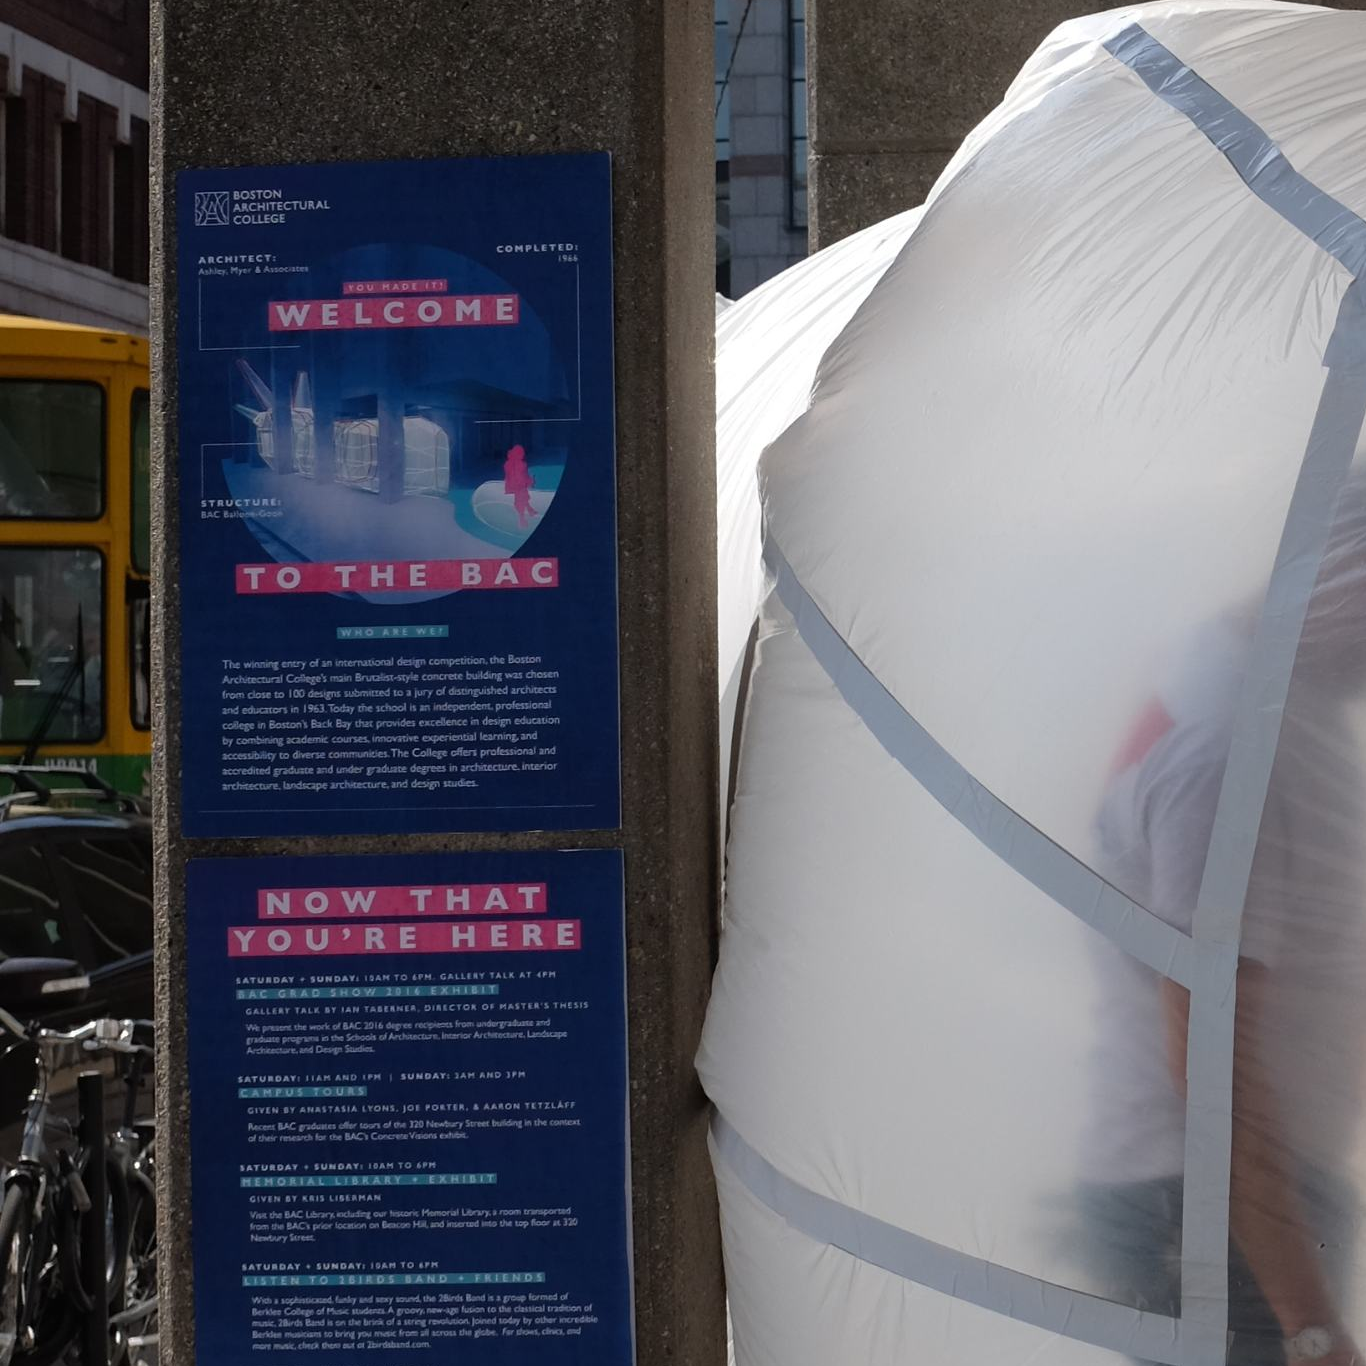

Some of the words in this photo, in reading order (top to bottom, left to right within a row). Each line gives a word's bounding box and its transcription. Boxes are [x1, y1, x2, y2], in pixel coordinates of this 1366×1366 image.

[233, 190, 282, 200] BOSTON
[233, 200, 330, 213] ARCHITECTURAL
[233, 213, 286, 225] COLLEGE
[496, 243, 579, 253] COMPLETED:
[198, 255, 277, 264] ARCHITECT:
[263, 265, 309, 273] Associates
[382, 283, 416, 291] MADE
[277, 297, 515, 327] WELCOME
[201, 498, 282, 508] STRUCTURE:
[201, 511, 220, 519] BAC
[243, 567, 301, 590] TO
[335, 563, 427, 588] THE
[461, 561, 553, 585] BAC
[341, 629, 374, 637] WHO
[383, 628, 408, 636] ARE
[223, 659, 240, 669] The
[243, 659, 279, 671] winning
[281, 658, 306, 670] entry
[309, 658, 319, 667] of
[334, 657, 394, 667] international
[396, 656, 426, 668] design
[489, 655, 505, 664] the
[507, 654, 541, 664] Boston
[222, 674, 283, 684] Architectural
[285, 673, 327, 685] College's
[329, 673, 352, 682] main
[421, 671, 463, 680] concrete
[465, 670, 502, 682] building
[525, 669, 559, 679] chosen
[222, 689, 244, 699] from
[247, 689, 271, 699] close
[274, 689, 284, 698] to
[288, 689, 305, 698] 100
[307, 688, 341, 700] designs
[343, 687, 390, 697] submitted
[393, 687, 403, 696] to
[414, 686, 432, 698] jury
[435, 686, 446, 695] of
[448, 685, 508, 698] distinguished
[510, 684, 556, 694] architects
[222, 705, 239, 714] and
[241, 704, 287, 714] educators
[290, 704, 299, 713] in
[327, 703, 354, 715] Today
[357, 703, 373, 712] the
[375, 702, 406, 712] school
[409, 702, 416, 711] is
[495, 700, 552, 712] professional
[267, 891, 376, 915] NOW
[410, 887, 540, 912] THAT
[234, 927, 417, 953] YOU'RE
[452, 923, 576, 948] HERE
[235, 975, 294, 984] SATURDAY
[310, 974, 359, 982] SUNDAY:
[394, 973, 407, 981] TO
[439, 972, 484, 980] GALLERY
[490, 971, 514, 979] TALK
[519, 971, 530, 979] AT
[537, 970, 556, 978] 4PM
[238, 990, 268, 999] BAC
[278, 989, 320, 998] GRAD
[330, 988, 376, 997] SHOW
[386, 987, 420, 996] 2016
[430, 985, 496, 995] EXHIBIT
[245, 1006, 289, 1015] GALLERY
[295, 1006, 319, 1014] TALK
[324, 1005, 336, 1013] BY
[341, 1005, 359, 1013] IAN
[424, 1003, 476, 1011] DIRECTOR
[553, 1001, 588, 1009] THESIS
[298, 1045, 314, 1053] and
[315, 1044, 342, 1055] Design
[237, 1074, 300, 1083] SATURDAY:
[335, 1073, 357, 1081] AND
[400, 1072, 449, 1080] SUNDAY:
[479, 1071, 501, 1079] AND
[506, 1070, 525, 1078] 3PM
[240, 1089, 303, 1098] CAMPUS
[314, 1088, 365, 1097] TOURS
[247, 1106, 278, 1114] GIVEN
[299, 1105, 357, 1113] ANASTASIA
[402, 1103, 420, 1111] JOE
[483, 1102, 520, 1110] AARON
[239, 1163, 298, 1171] SATURDAY
[314, 1162, 363, 1170] SUNDAY:
[398, 1161, 411, 1169] TO
[416, 1161, 436, 1169] 6PM
[242, 1177, 325, 1186] MEMORIAL
[335, 1176, 402, 1185] LIBRARY
[428, 1175, 495, 1184] EXHIBIT
[249, 1195, 280, 1203] GIVEN
[285, 1194, 296, 1202] BY
[241, 1262, 300, 1271] SATURDAY
[316, 1261, 365, 1269] SUNDAY:
[400, 1260, 414, 1268] TO
[418, 1260, 438, 1268] 6PM
[244, 1276, 300, 1285] LISTEN
[309, 1275, 329, 1284] TO
[405, 1274, 448, 1283] BAND
[474, 1273, 543, 1282] FRIENDS
